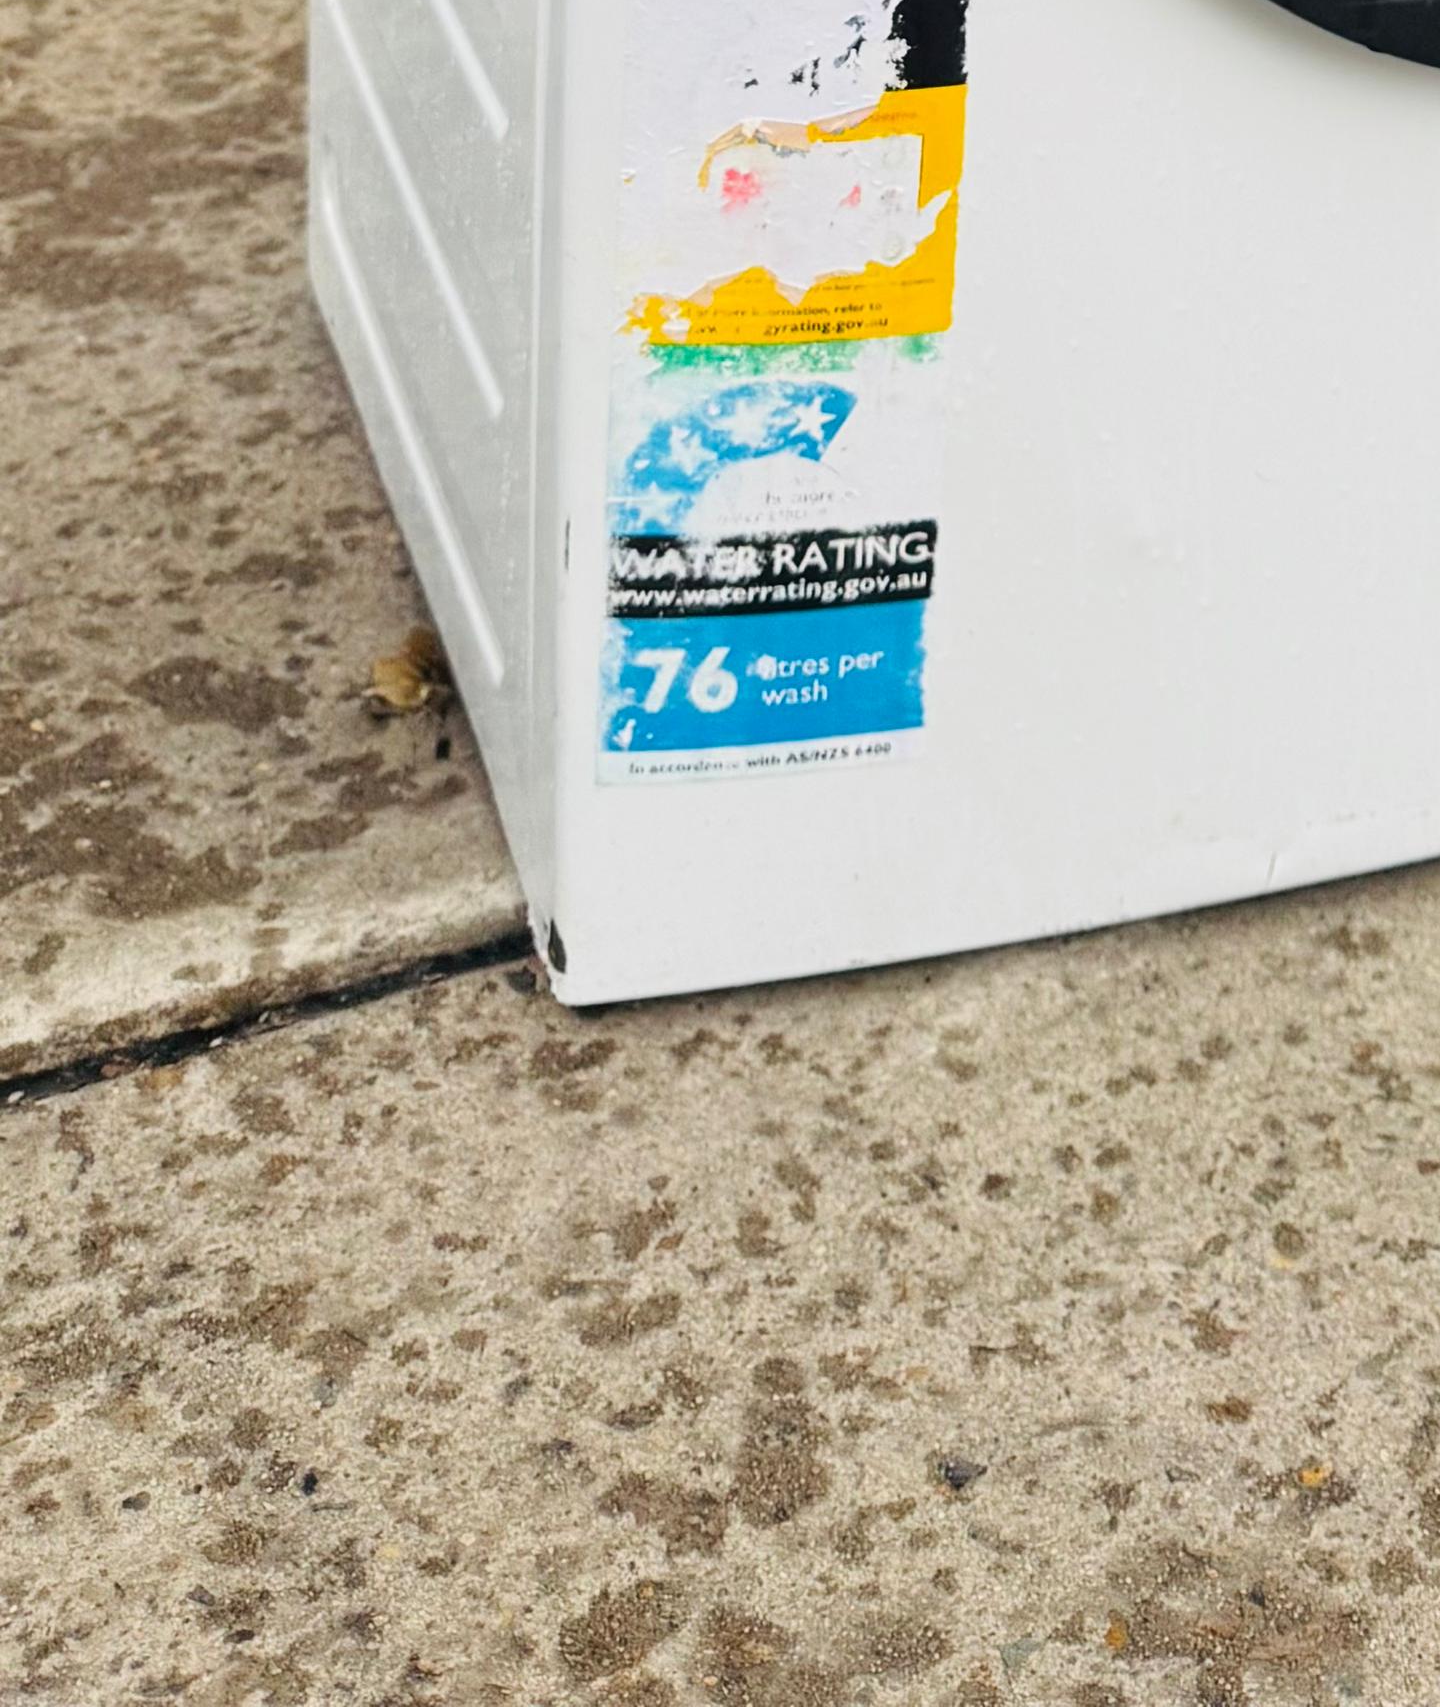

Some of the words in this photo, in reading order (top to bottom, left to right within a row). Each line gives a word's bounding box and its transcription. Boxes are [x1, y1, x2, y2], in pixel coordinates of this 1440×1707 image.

[772, 531, 931, 576] RATING
[631, 647, 738, 713] 76
[838, 650, 885, 678] per
[761, 679, 828, 706] wash
